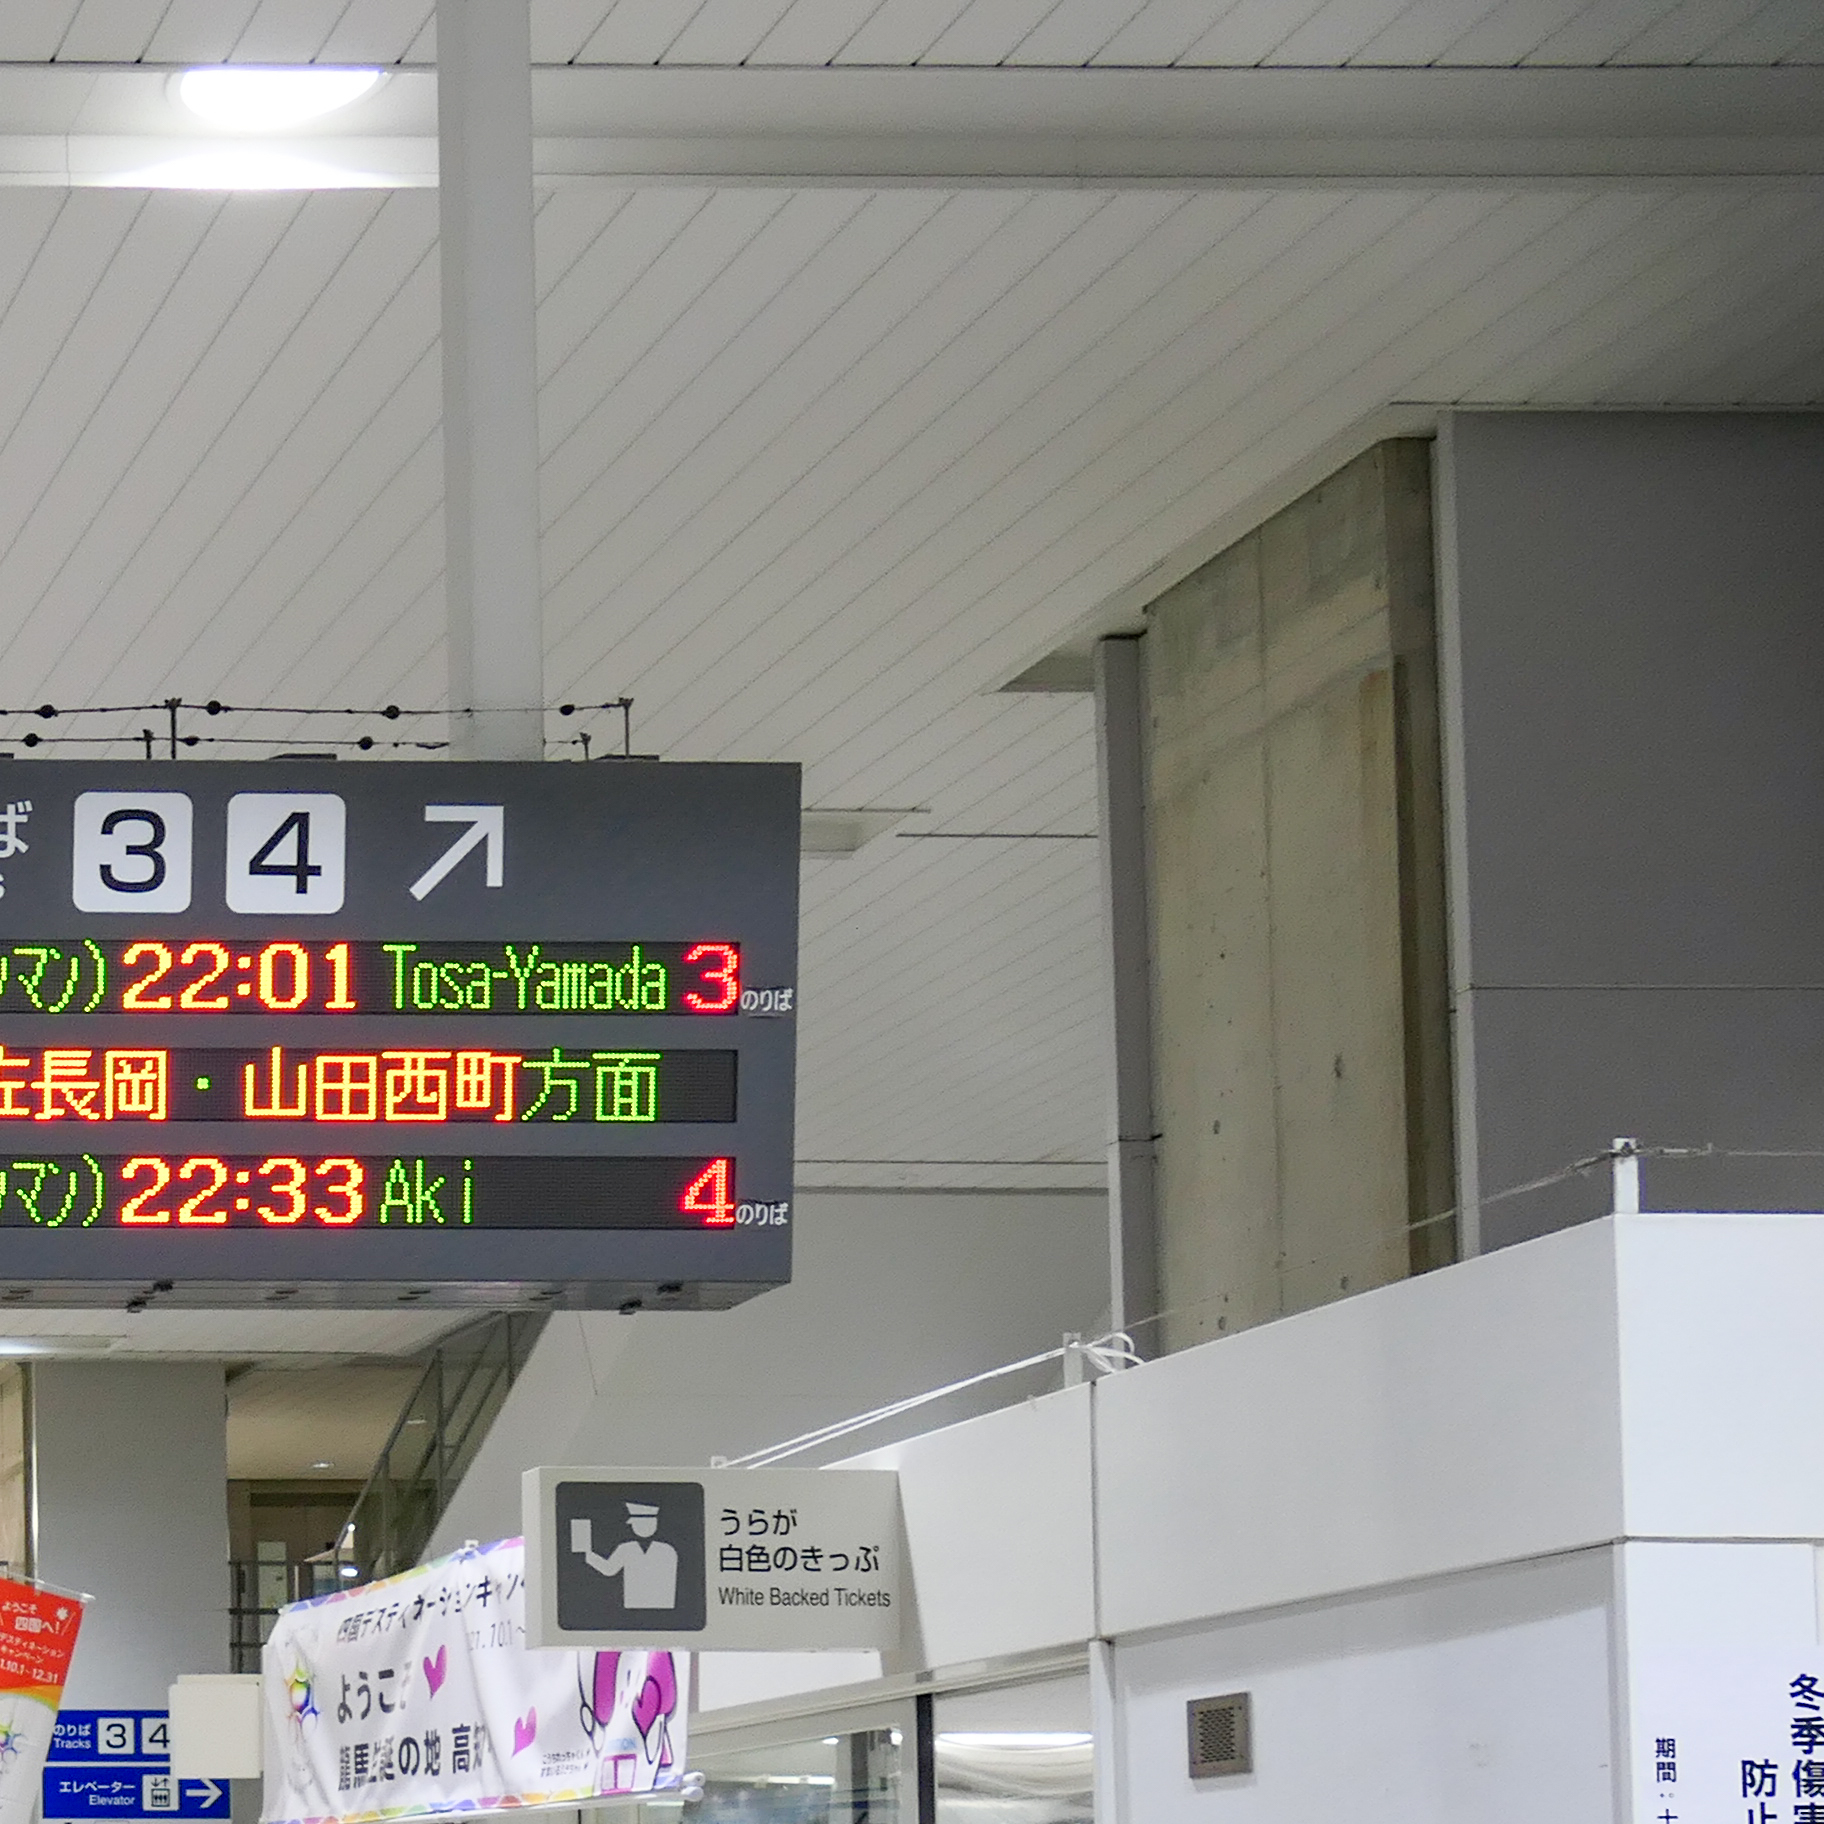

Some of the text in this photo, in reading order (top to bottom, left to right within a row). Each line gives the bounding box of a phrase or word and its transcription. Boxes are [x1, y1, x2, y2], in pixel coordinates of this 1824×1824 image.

[98, 811, 169, 895] 3
[248, 811, 325, 895] 4
[121, 941, 356, 1010] 22:01
[380, 942, 668, 1012] Tosa-Yamada
[683, 944, 738, 1012] 3
[740, 987, 793, 1014] のりば
[119, 1155, 367, 1225] 22:33
[379, 1157, 475, 1225] Aki
[681, 1157, 734, 1226] 4
[736, 1198, 789, 1226] のりば
[721, 1509, 797, 1535] うらが
[719, 1544, 879, 1572] 白色のきっぷ
[719, 1587, 891, 1607] White Backed Tickets
[53, 1723, 170, 1748] のりば 3 4
[53, 1738, 91, 1749] Tracks
[59, 1781, 135, 1793] エレベーター
[89, 1795, 135, 1806] Elevator
